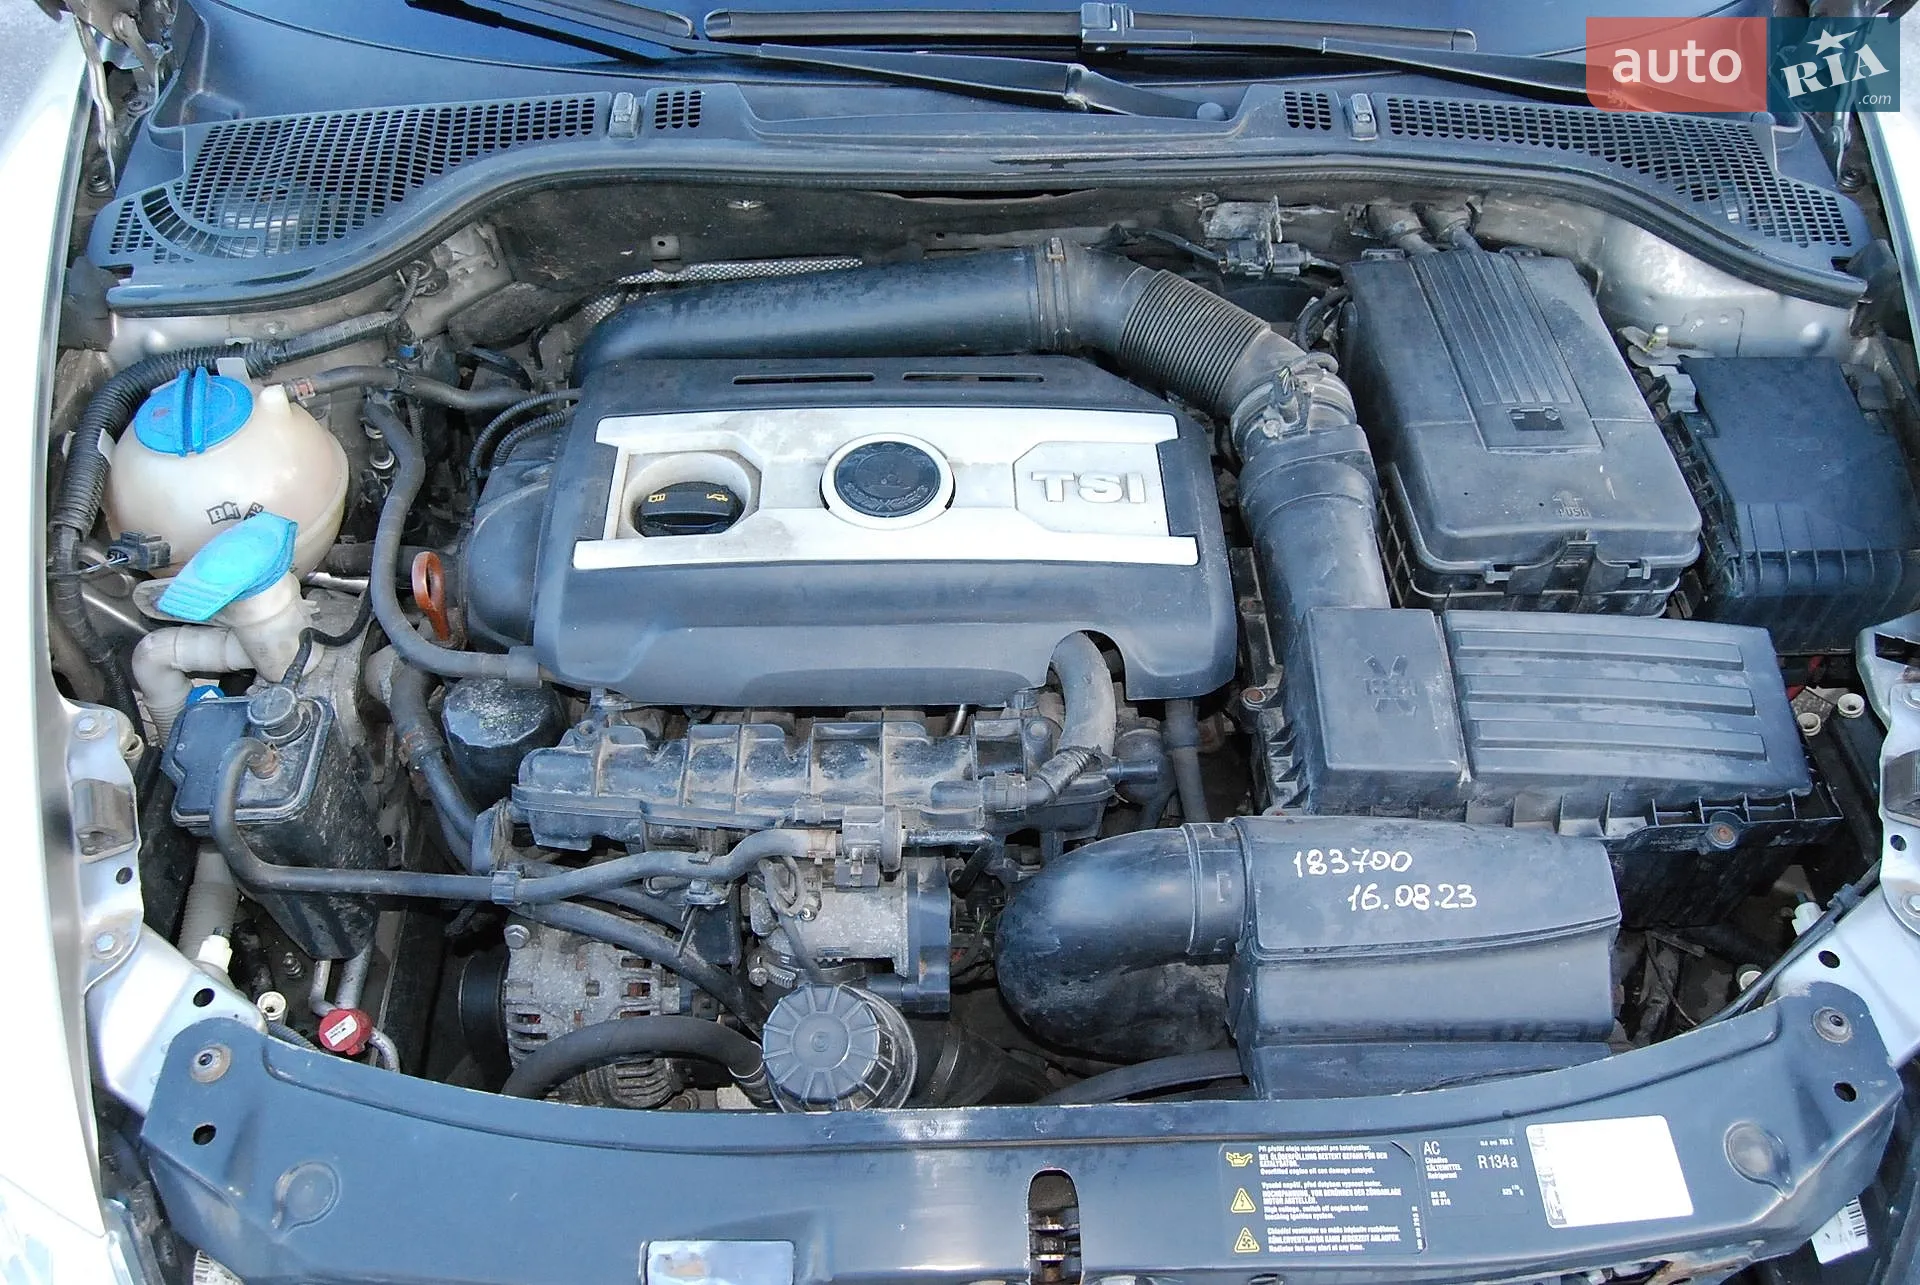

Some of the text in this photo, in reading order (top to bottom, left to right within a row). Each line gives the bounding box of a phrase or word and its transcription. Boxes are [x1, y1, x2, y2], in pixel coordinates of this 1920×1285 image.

[1030, 470, 1146, 504] TSI
[1293, 848, 1413, 878] 183700
[1347, 883, 1477, 911] 16.08.23
[1424, 1141, 1440, 1155] AC
